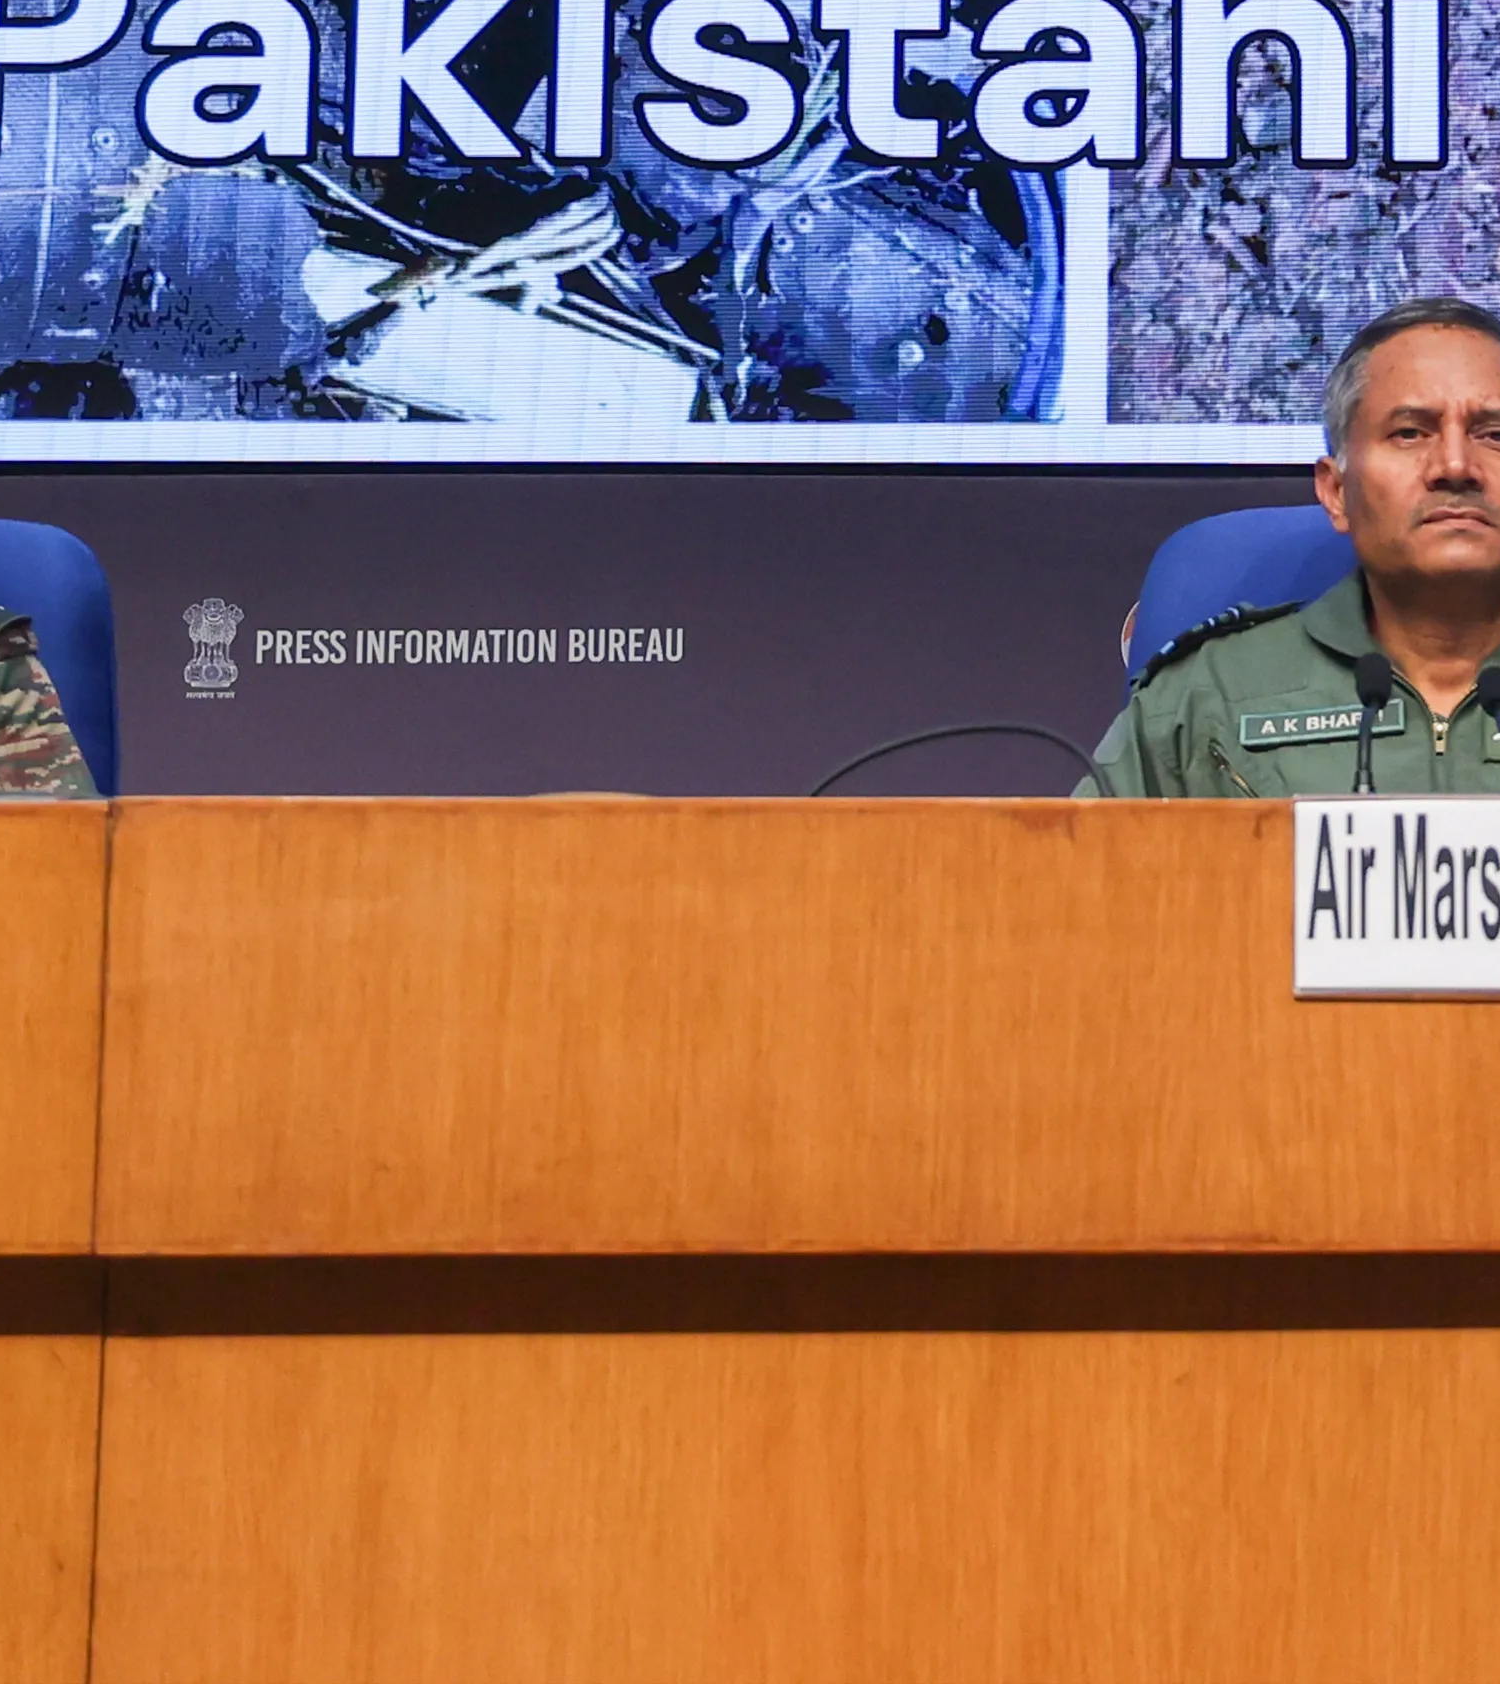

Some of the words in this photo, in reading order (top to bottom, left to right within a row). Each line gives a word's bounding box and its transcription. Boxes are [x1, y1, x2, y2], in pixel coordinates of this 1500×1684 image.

[256, 629, 347, 664] PRESS
[356, 628, 557, 664] INFORMATION
[568, 628, 684, 663] BUREAU
[1261, 720, 1276, 735] A
[1284, 718, 1298, 733] K
[1308, 814, 1375, 939] Air
